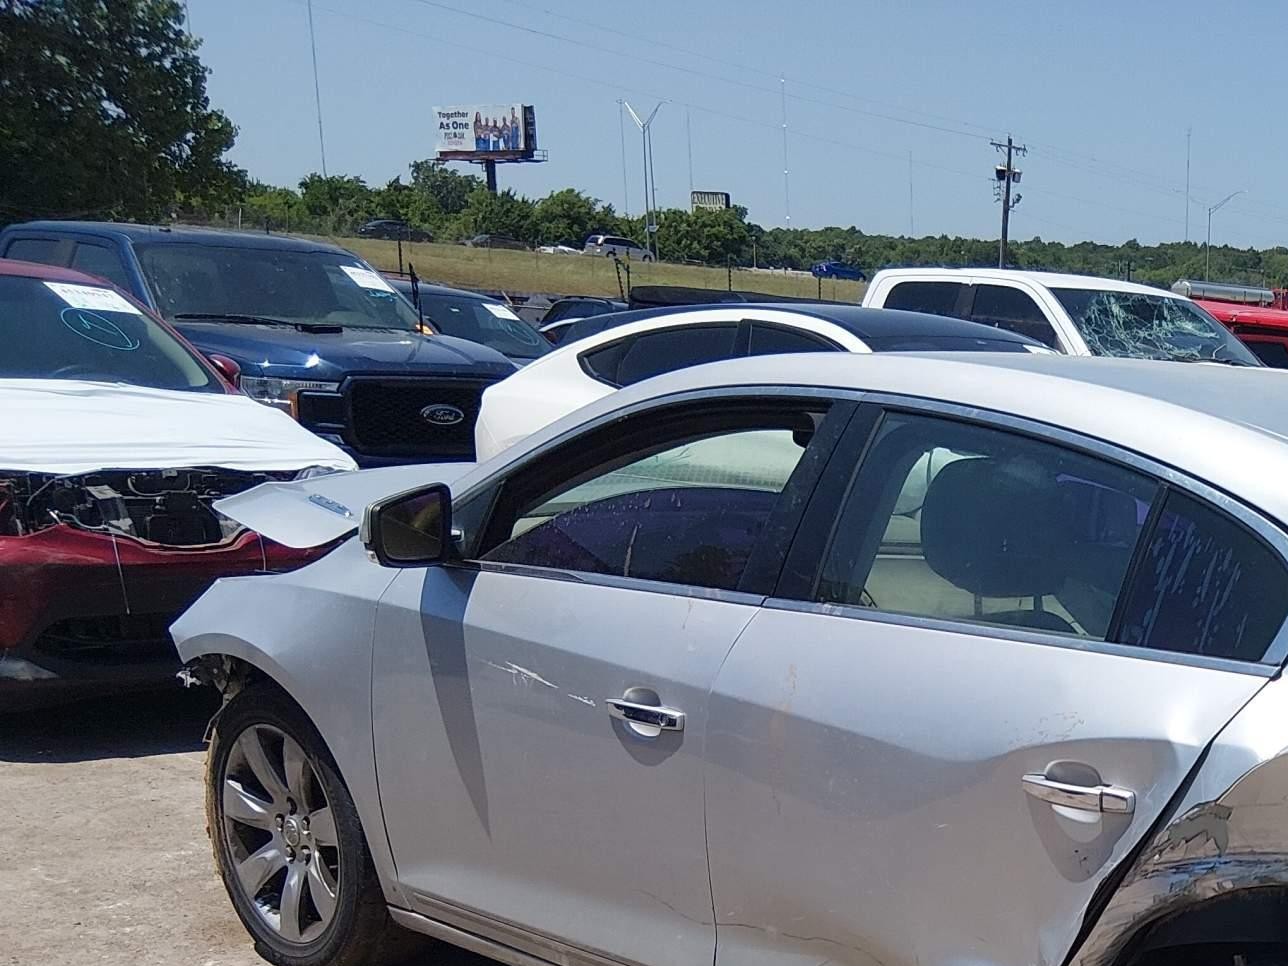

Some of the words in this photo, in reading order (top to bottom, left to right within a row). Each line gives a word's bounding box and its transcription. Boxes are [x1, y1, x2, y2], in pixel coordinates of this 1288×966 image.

[437, 110, 469, 120] Together
[439, 121, 451, 130] As
[452, 121, 470, 130] One
